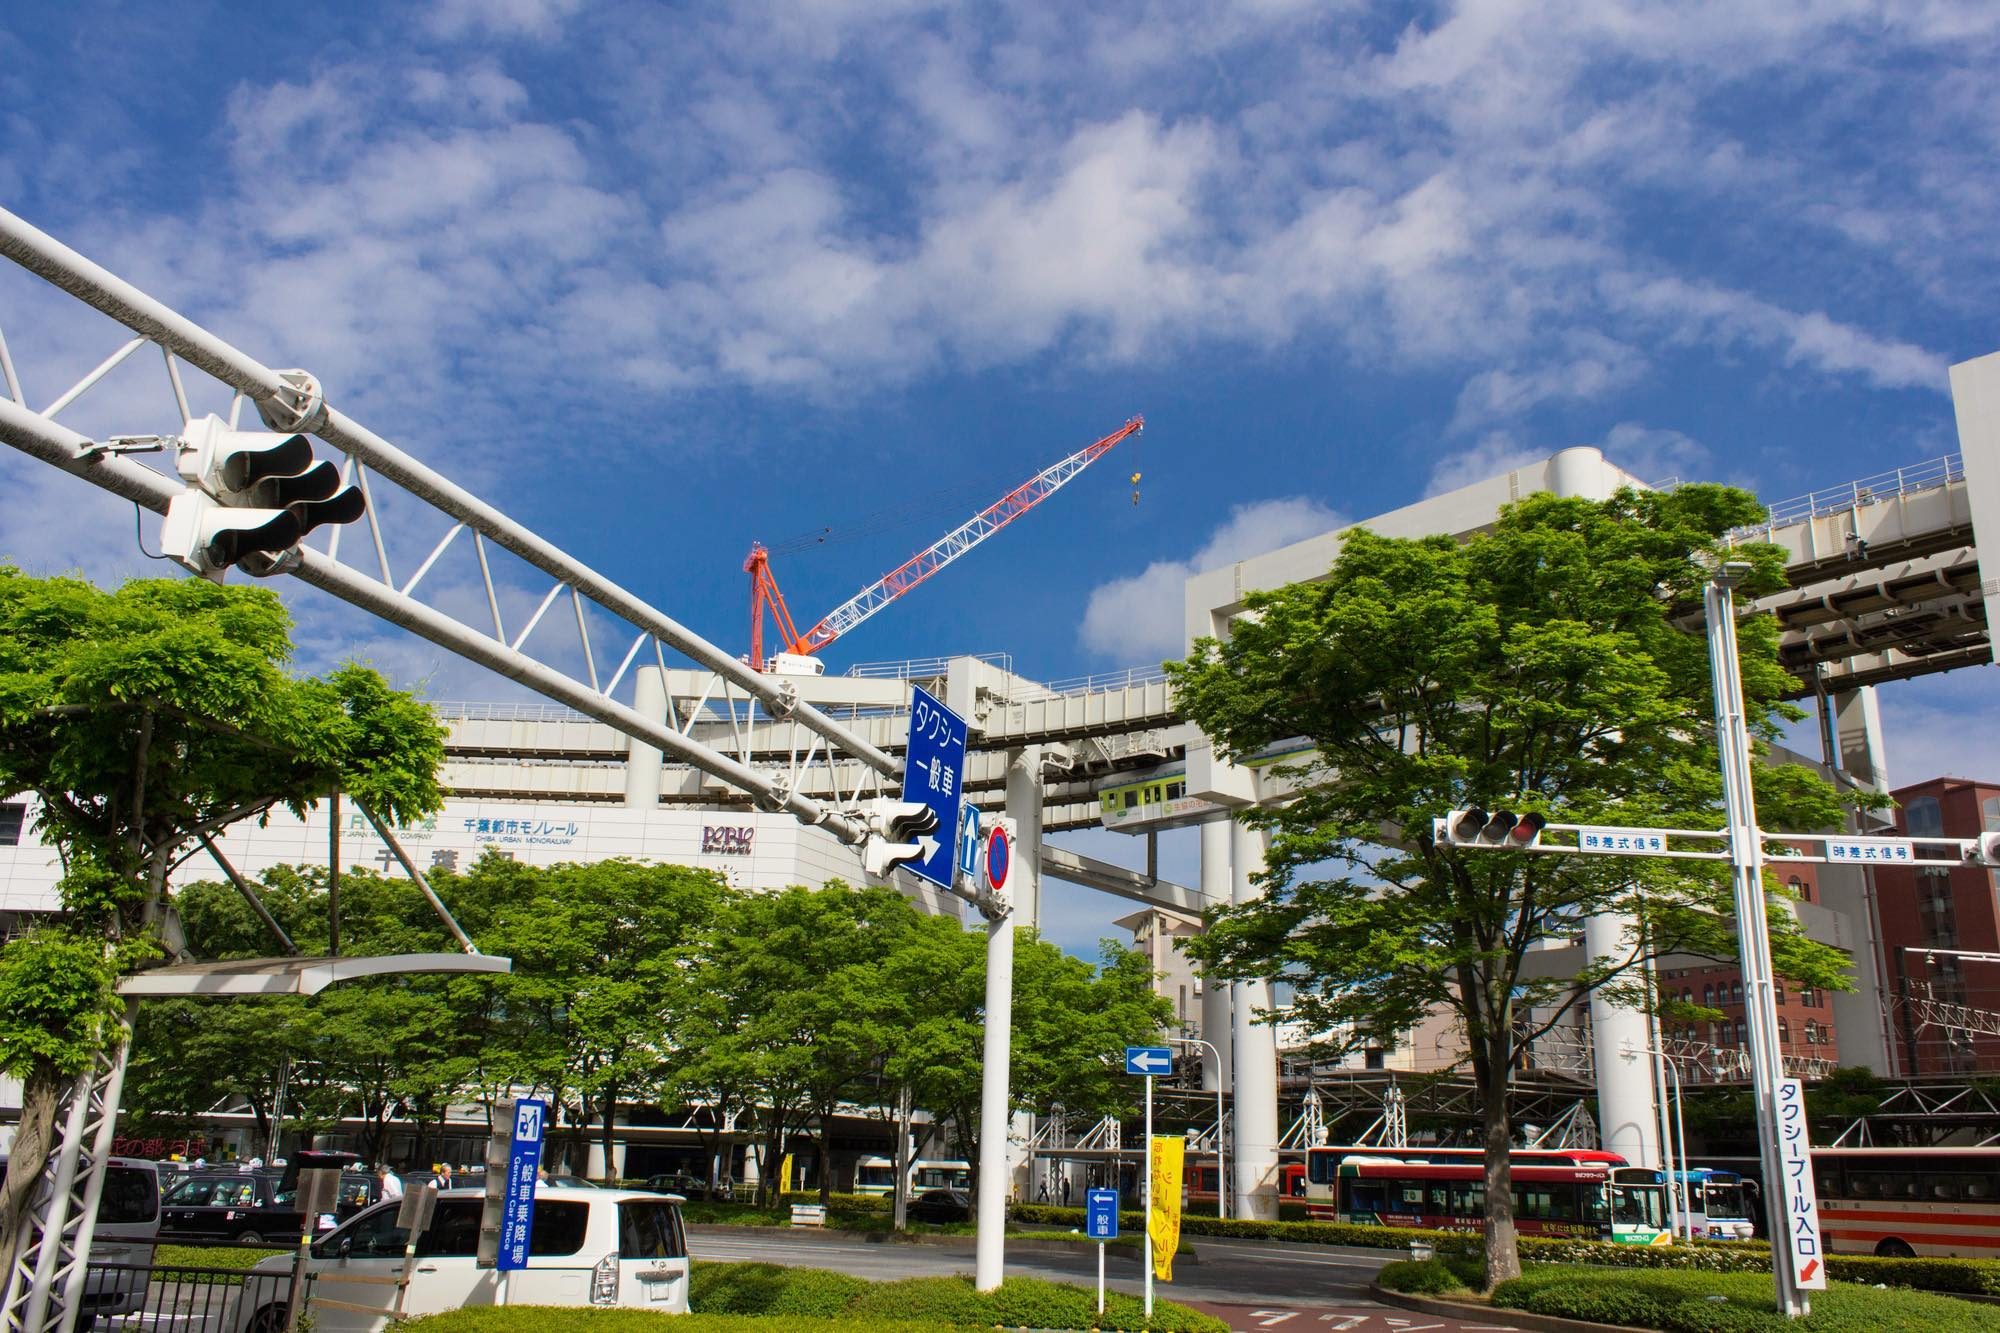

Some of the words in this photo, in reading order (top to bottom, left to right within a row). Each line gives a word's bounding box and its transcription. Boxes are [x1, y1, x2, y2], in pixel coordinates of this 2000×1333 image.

[916, 701, 962, 748] タクシー
[915, 755, 954, 798] 一般車
[347, 831, 368, 839] JAPAN
[400, 832, 434, 840] COMPANY
[464, 818, 578, 836] 千葉都市モノレール
[1585, 835, 1661, 850] 時差式信号
[1833, 845, 1908, 860] 時差式信号
[510, 1156, 521, 1196] General
[1779, 1084, 1816, 1256] タクシープール入口
[509, 1199, 517, 1218] Car
[512, 1151, 536, 1264] 一般車乗降場
[1096, 1207, 1109, 1235] 一般車
[504, 1221, 514, 1251] Place
